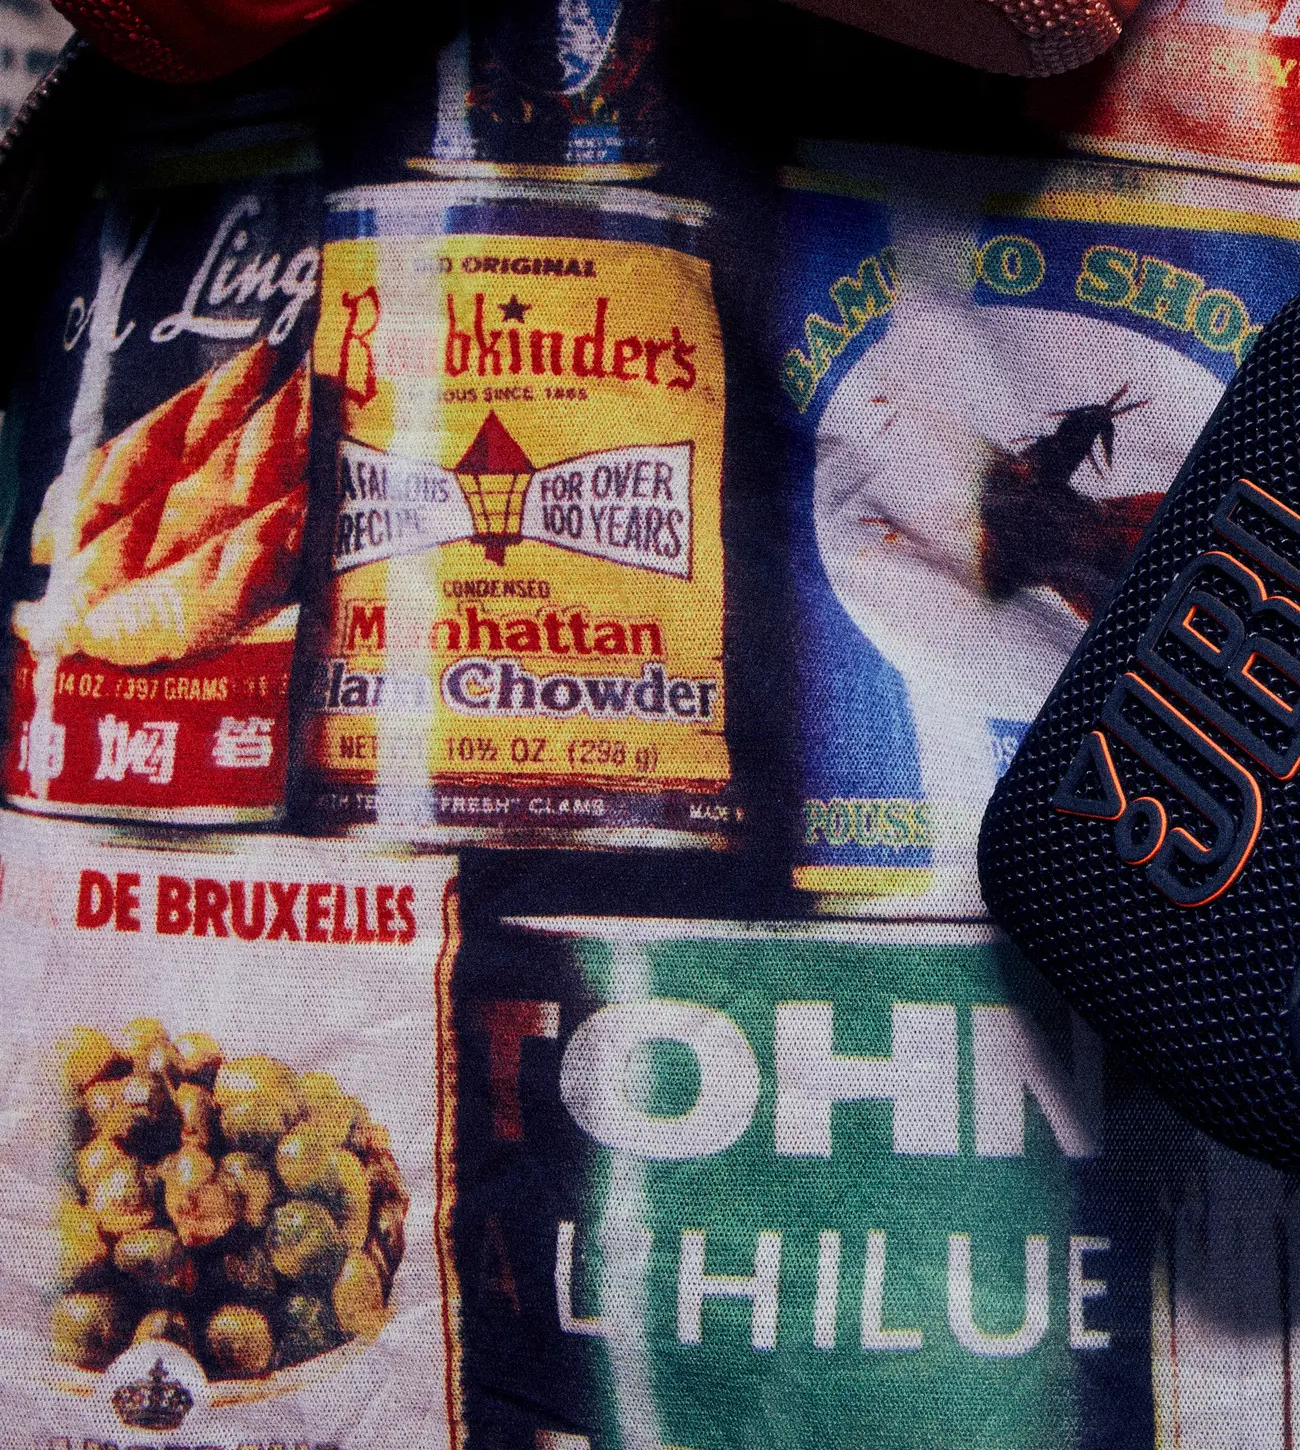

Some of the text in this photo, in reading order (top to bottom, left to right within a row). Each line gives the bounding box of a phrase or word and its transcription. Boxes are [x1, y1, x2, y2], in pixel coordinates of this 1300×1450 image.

[150, 195, 322, 346] Ling
[462, 256, 597, 278] ORIGINAL
[541, 474, 583, 504] FOR
[590, 465, 674, 504] OVER
[543, 504, 584, 539] 100
[589, 505, 687, 558] YEARS
[442, 580, 551, 598] CONDENSED
[347, 604, 663, 656] Mnhattan
[164, 676, 229, 700] GRAMS
[445, 660, 716, 718] Chowder
[76, 869, 142, 932] DE
[155, 875, 417, 944] BRUXELLES
